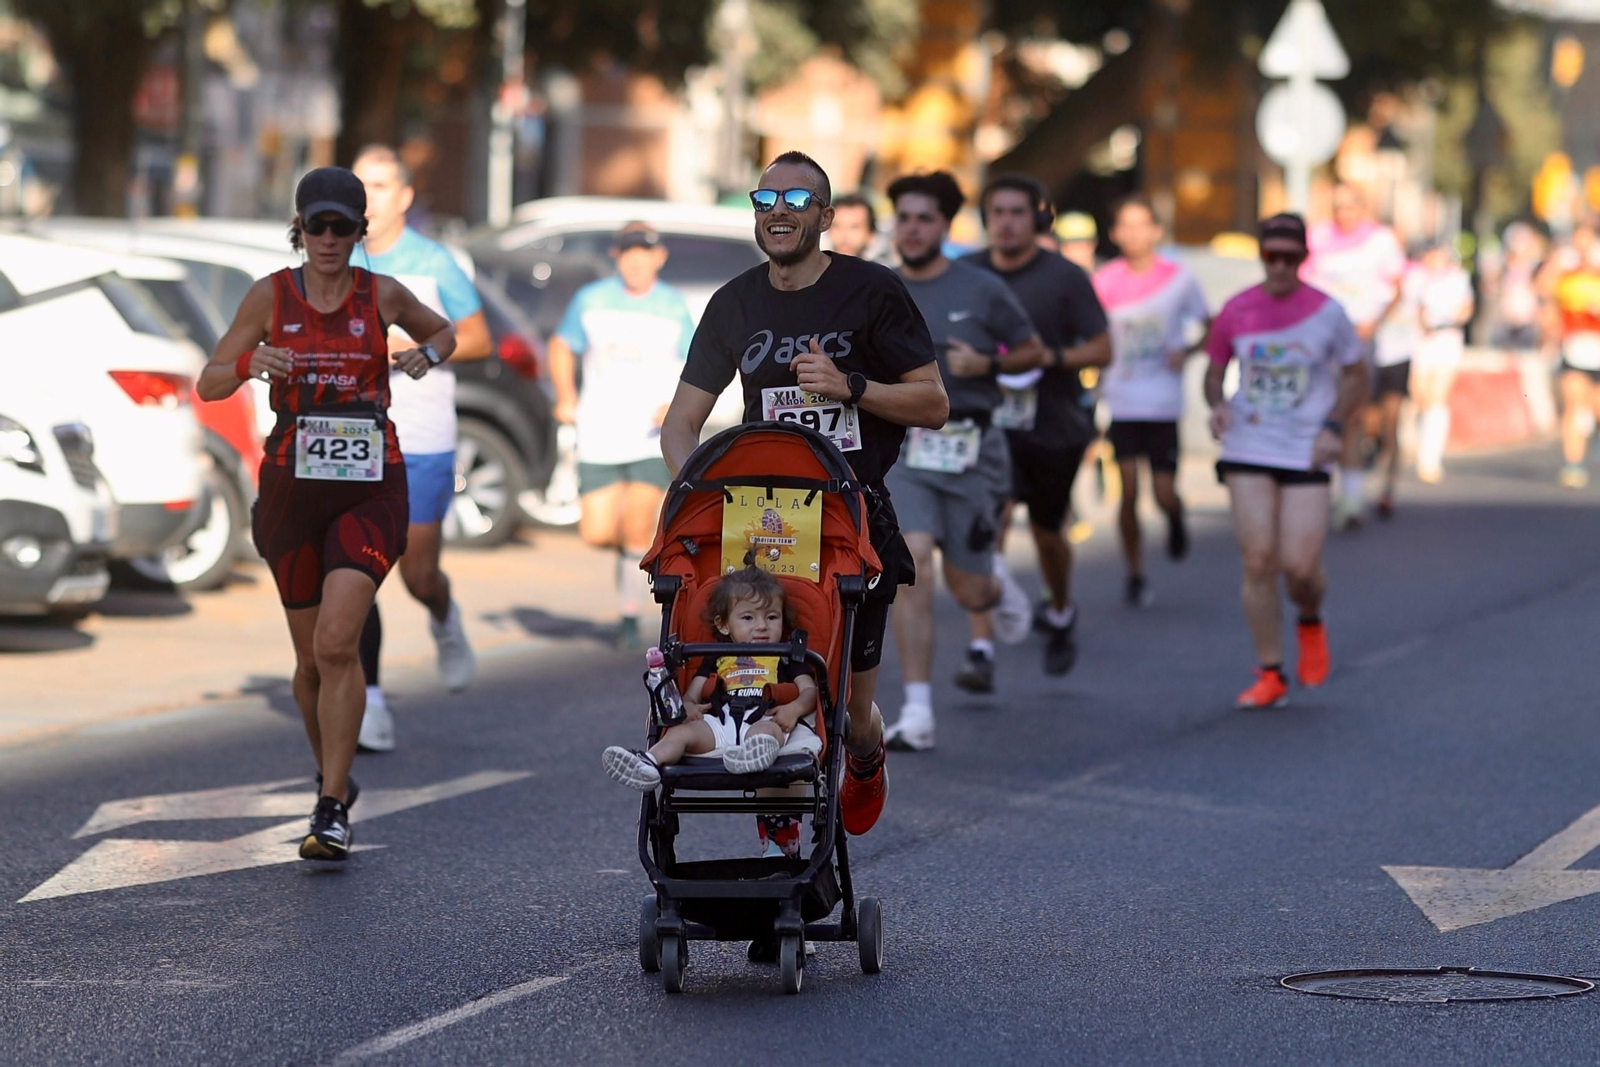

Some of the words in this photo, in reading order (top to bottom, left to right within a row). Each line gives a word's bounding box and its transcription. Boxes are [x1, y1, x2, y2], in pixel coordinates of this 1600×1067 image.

[318, 374, 357, 386] CASA
[342, 427, 370, 435] 2025
[307, 438, 370, 461] 423
[740, 495, 800, 510] LOLA
